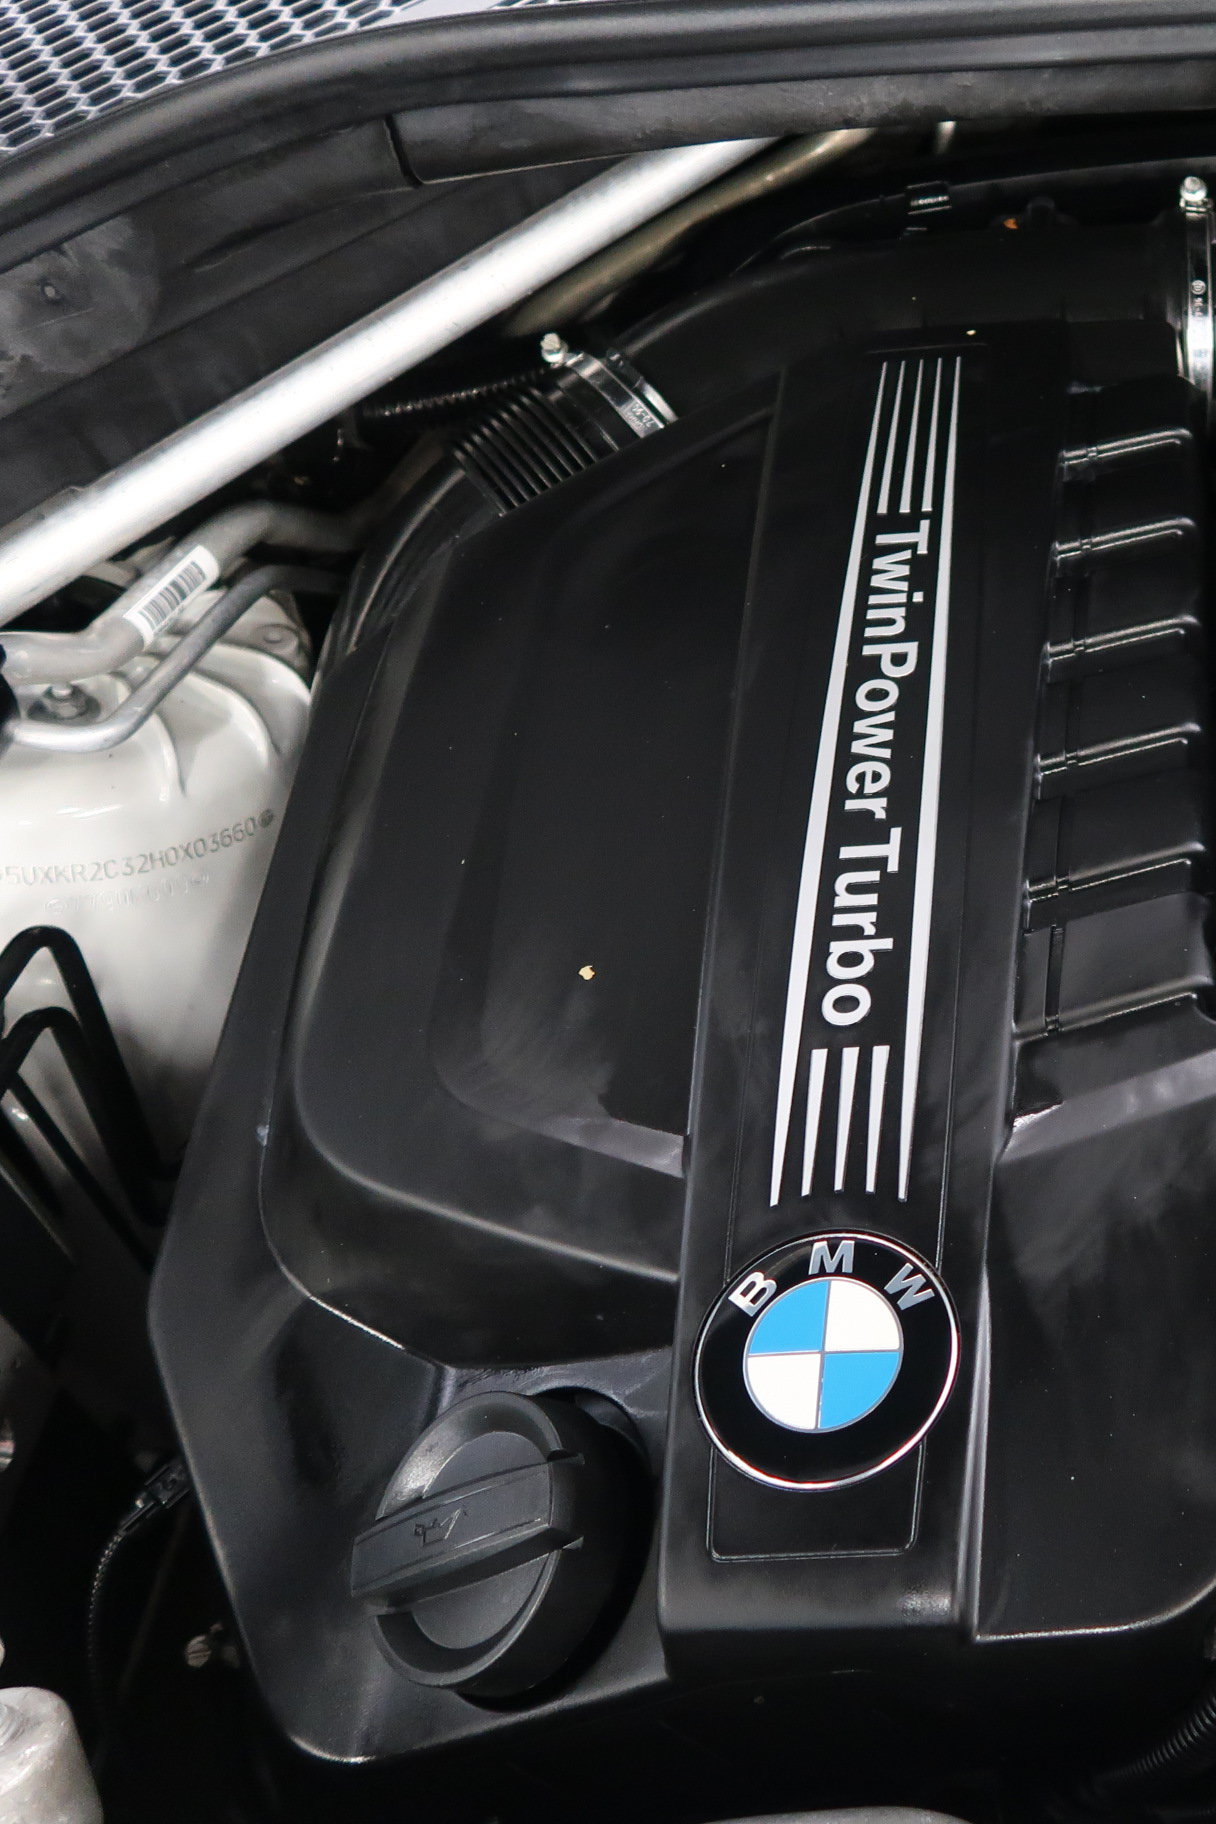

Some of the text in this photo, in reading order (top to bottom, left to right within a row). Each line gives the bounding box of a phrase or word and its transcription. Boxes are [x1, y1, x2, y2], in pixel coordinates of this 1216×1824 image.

[821, 519, 931, 1027] TwinPower Turbo
[727, 1239, 936, 1318] BMW
